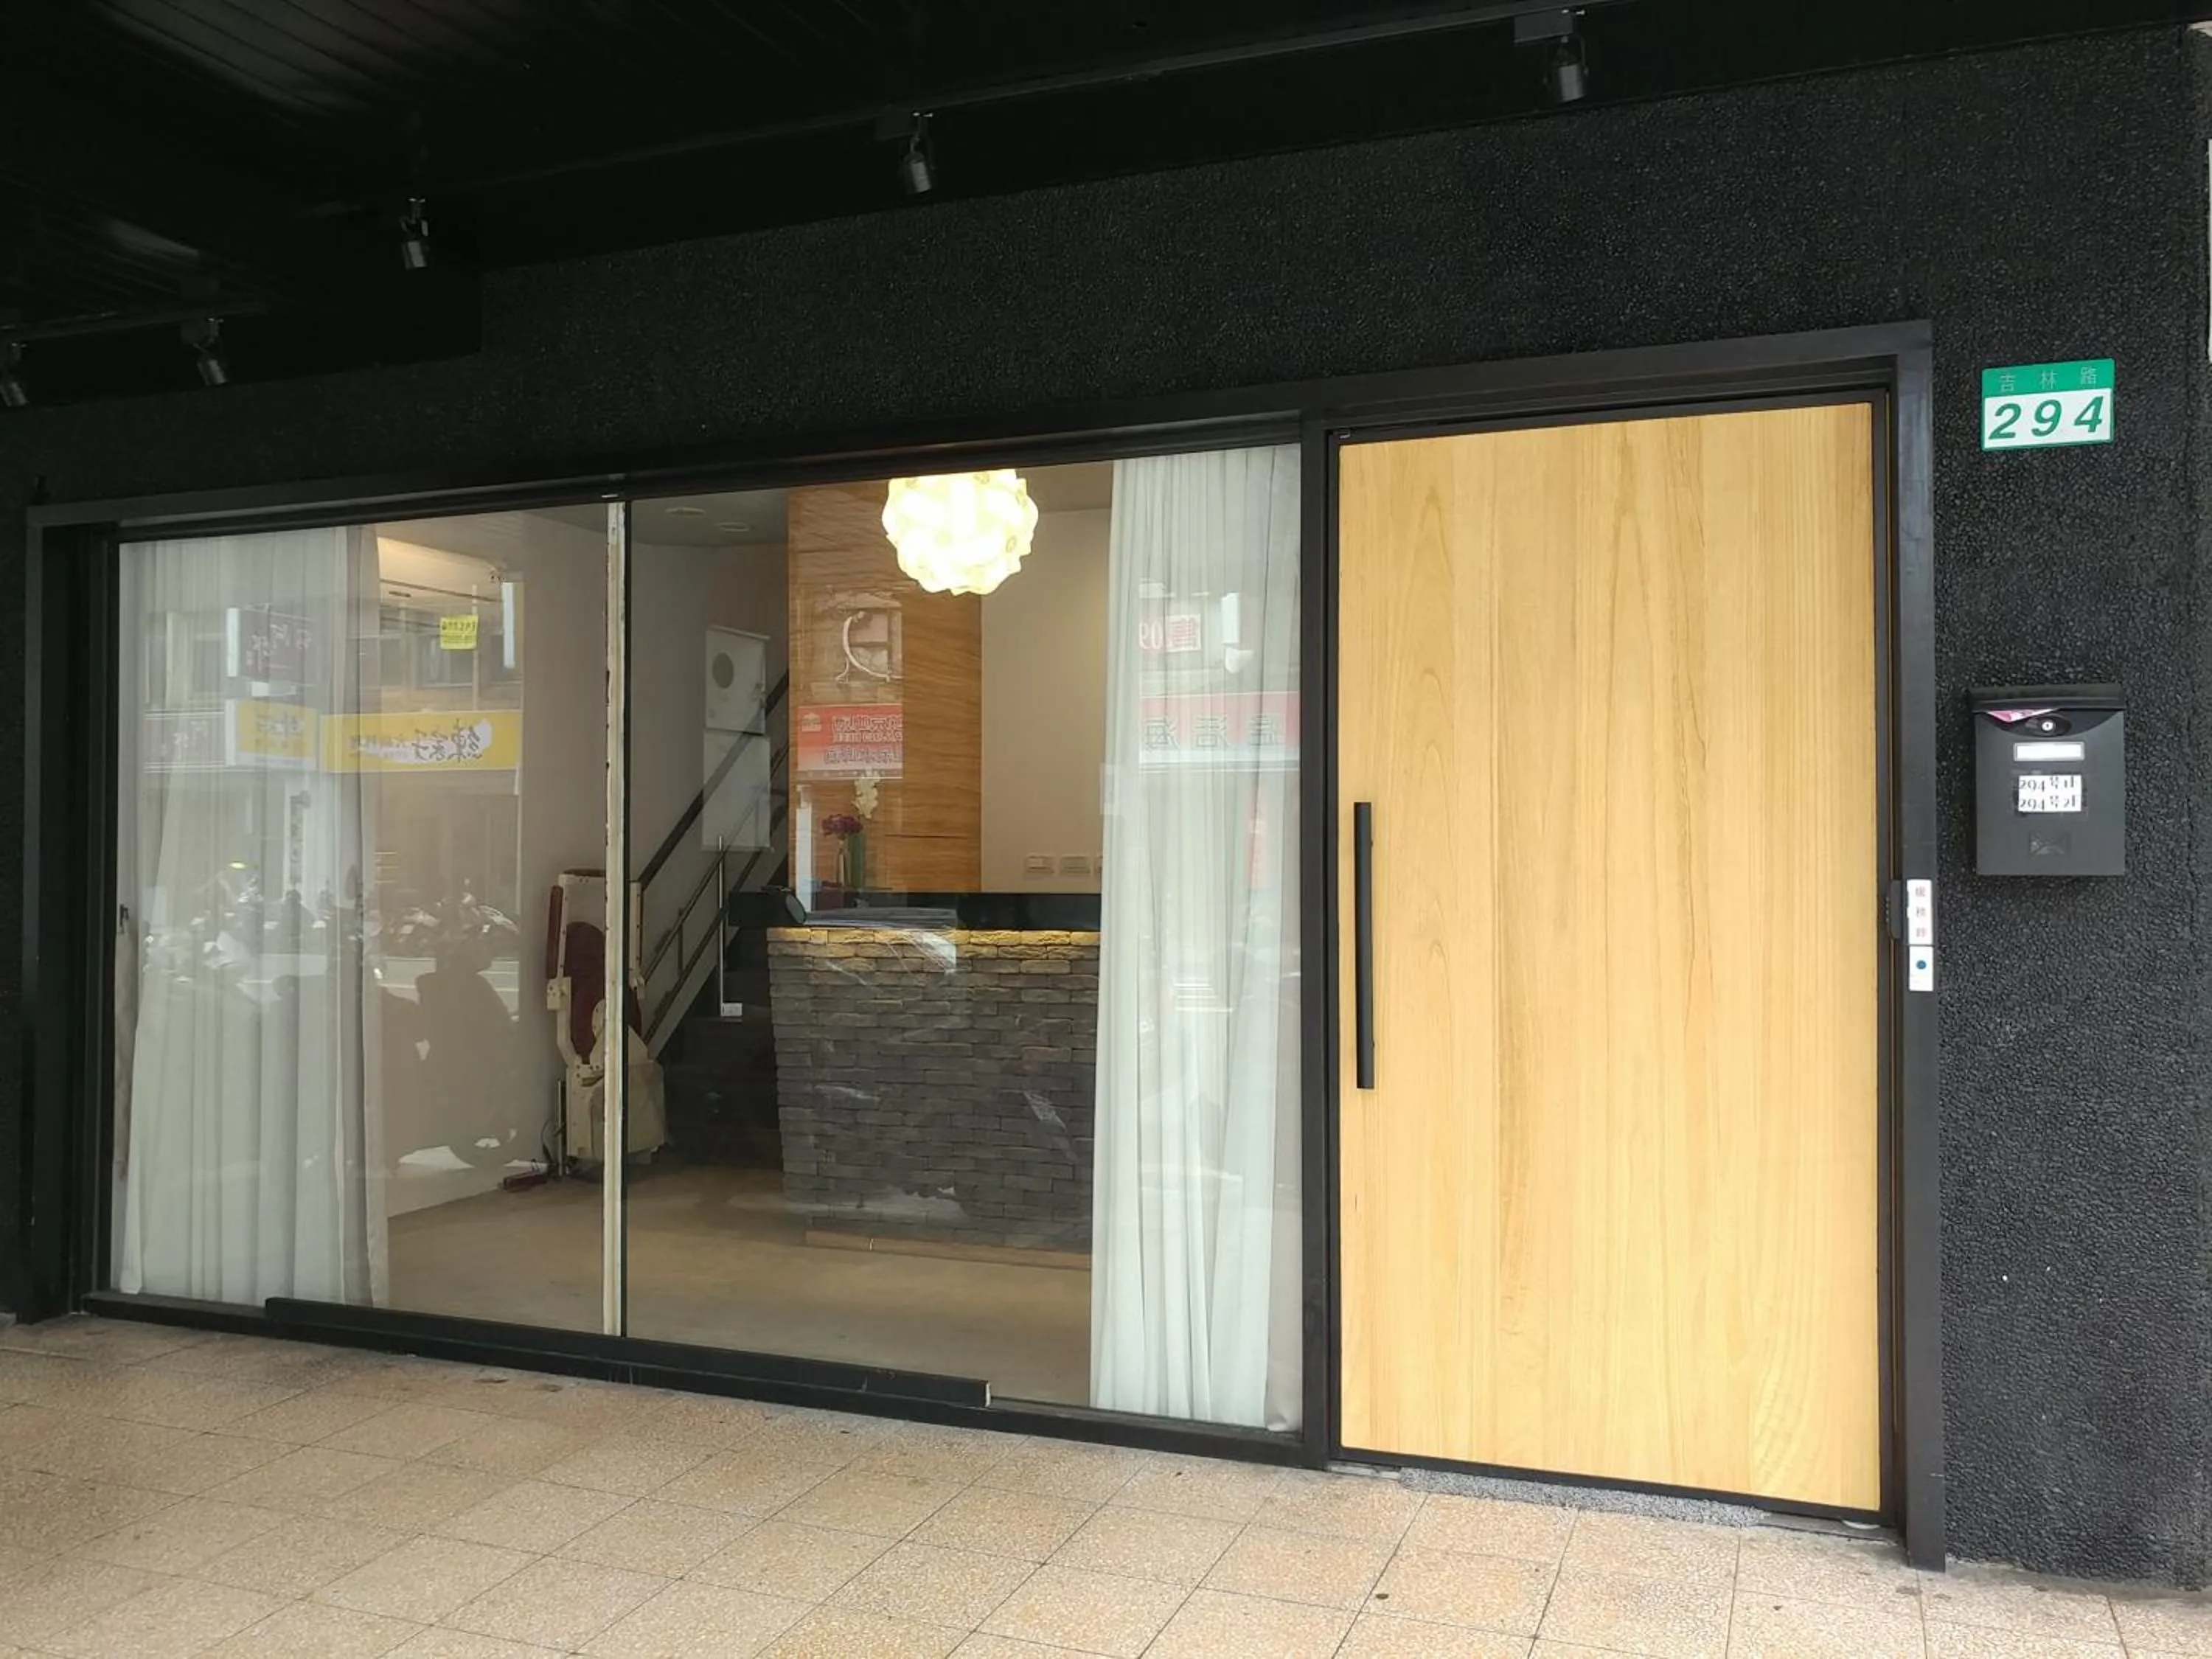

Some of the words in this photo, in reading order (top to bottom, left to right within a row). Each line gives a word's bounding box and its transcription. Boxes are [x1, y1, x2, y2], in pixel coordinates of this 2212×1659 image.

[1999, 366, 2097, 392] 吉林路
[1989, 395, 2104, 440] 294
